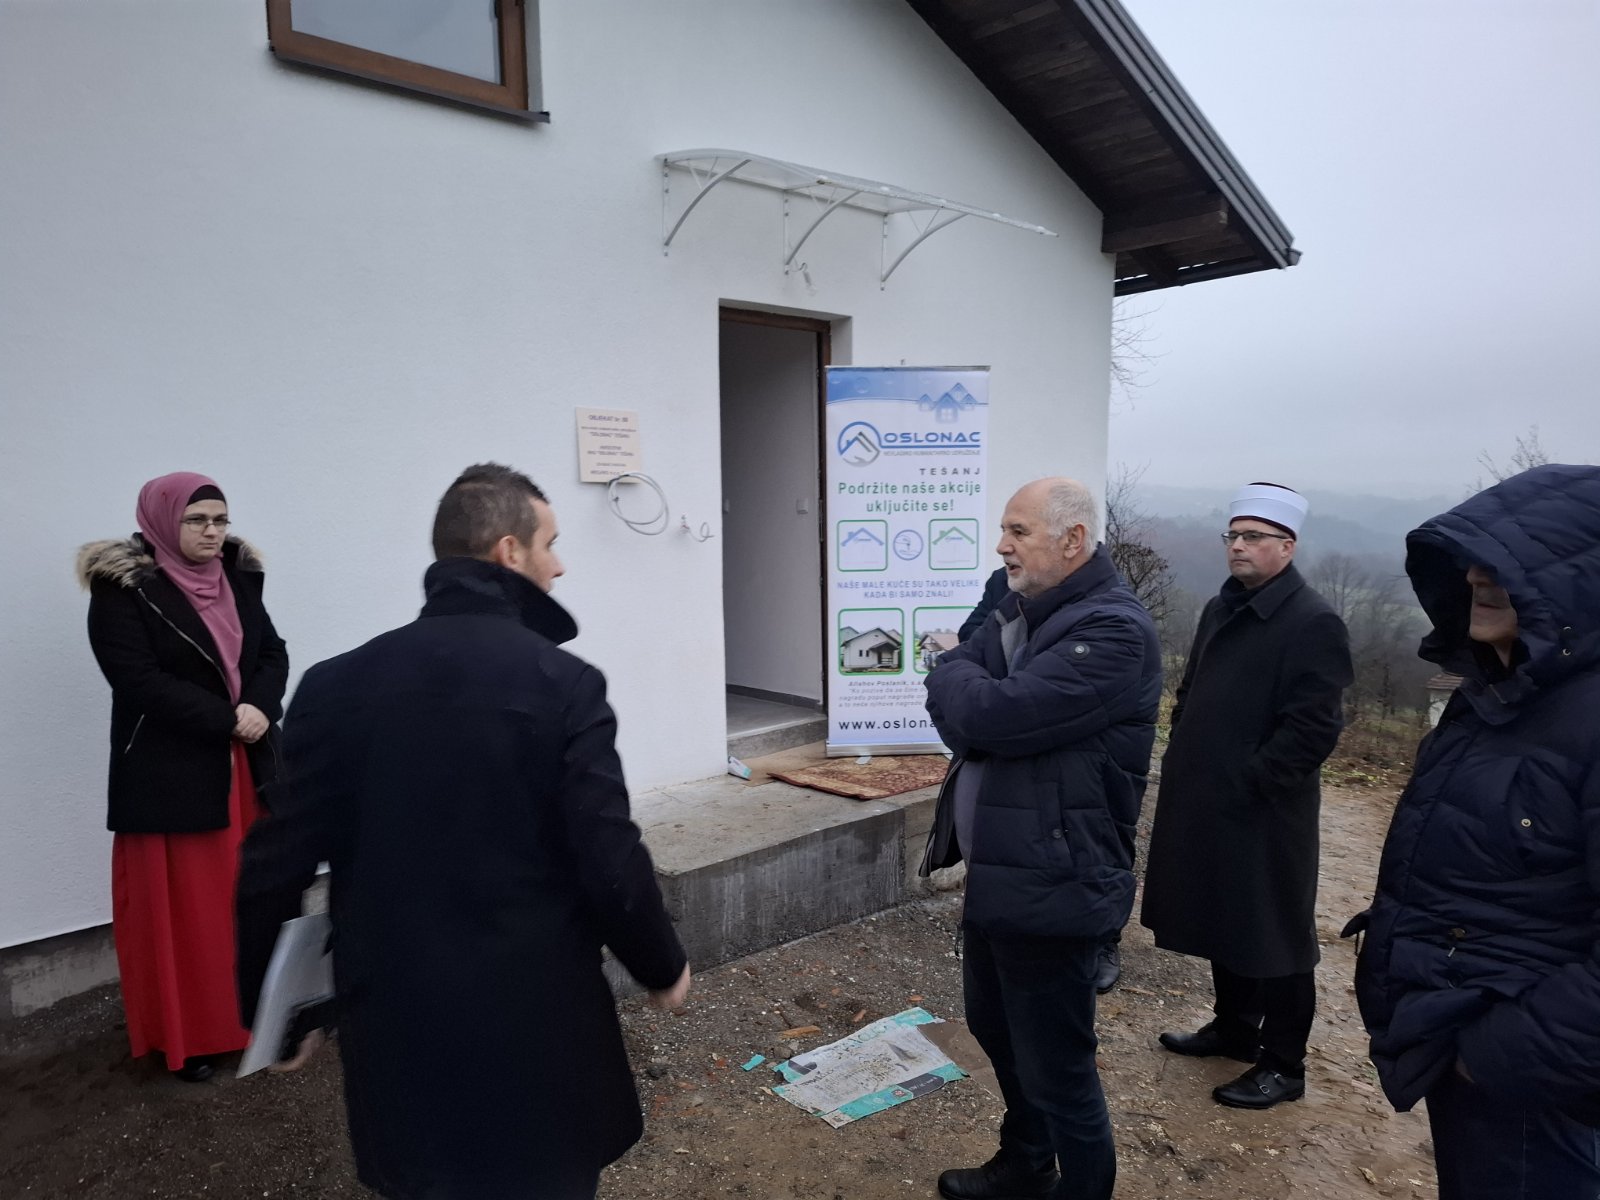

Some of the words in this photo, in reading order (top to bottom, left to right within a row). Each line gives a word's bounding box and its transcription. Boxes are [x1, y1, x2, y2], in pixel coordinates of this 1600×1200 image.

[883, 431, 981, 443] OSLONAC
[920, 467, 980, 475] TEŠANJ
[838, 482, 897, 494] Podržite
[902, 482, 934, 494] naše
[940, 481, 981, 495] akcije
[867, 499, 928, 514] uključite
[933, 499, 954, 512] se!
[837, 580, 860, 589] NAŠE
[862, 580, 884, 588] MALE
[950, 579, 979, 587] VELIKE
[900, 590, 924, 598] SAMO
